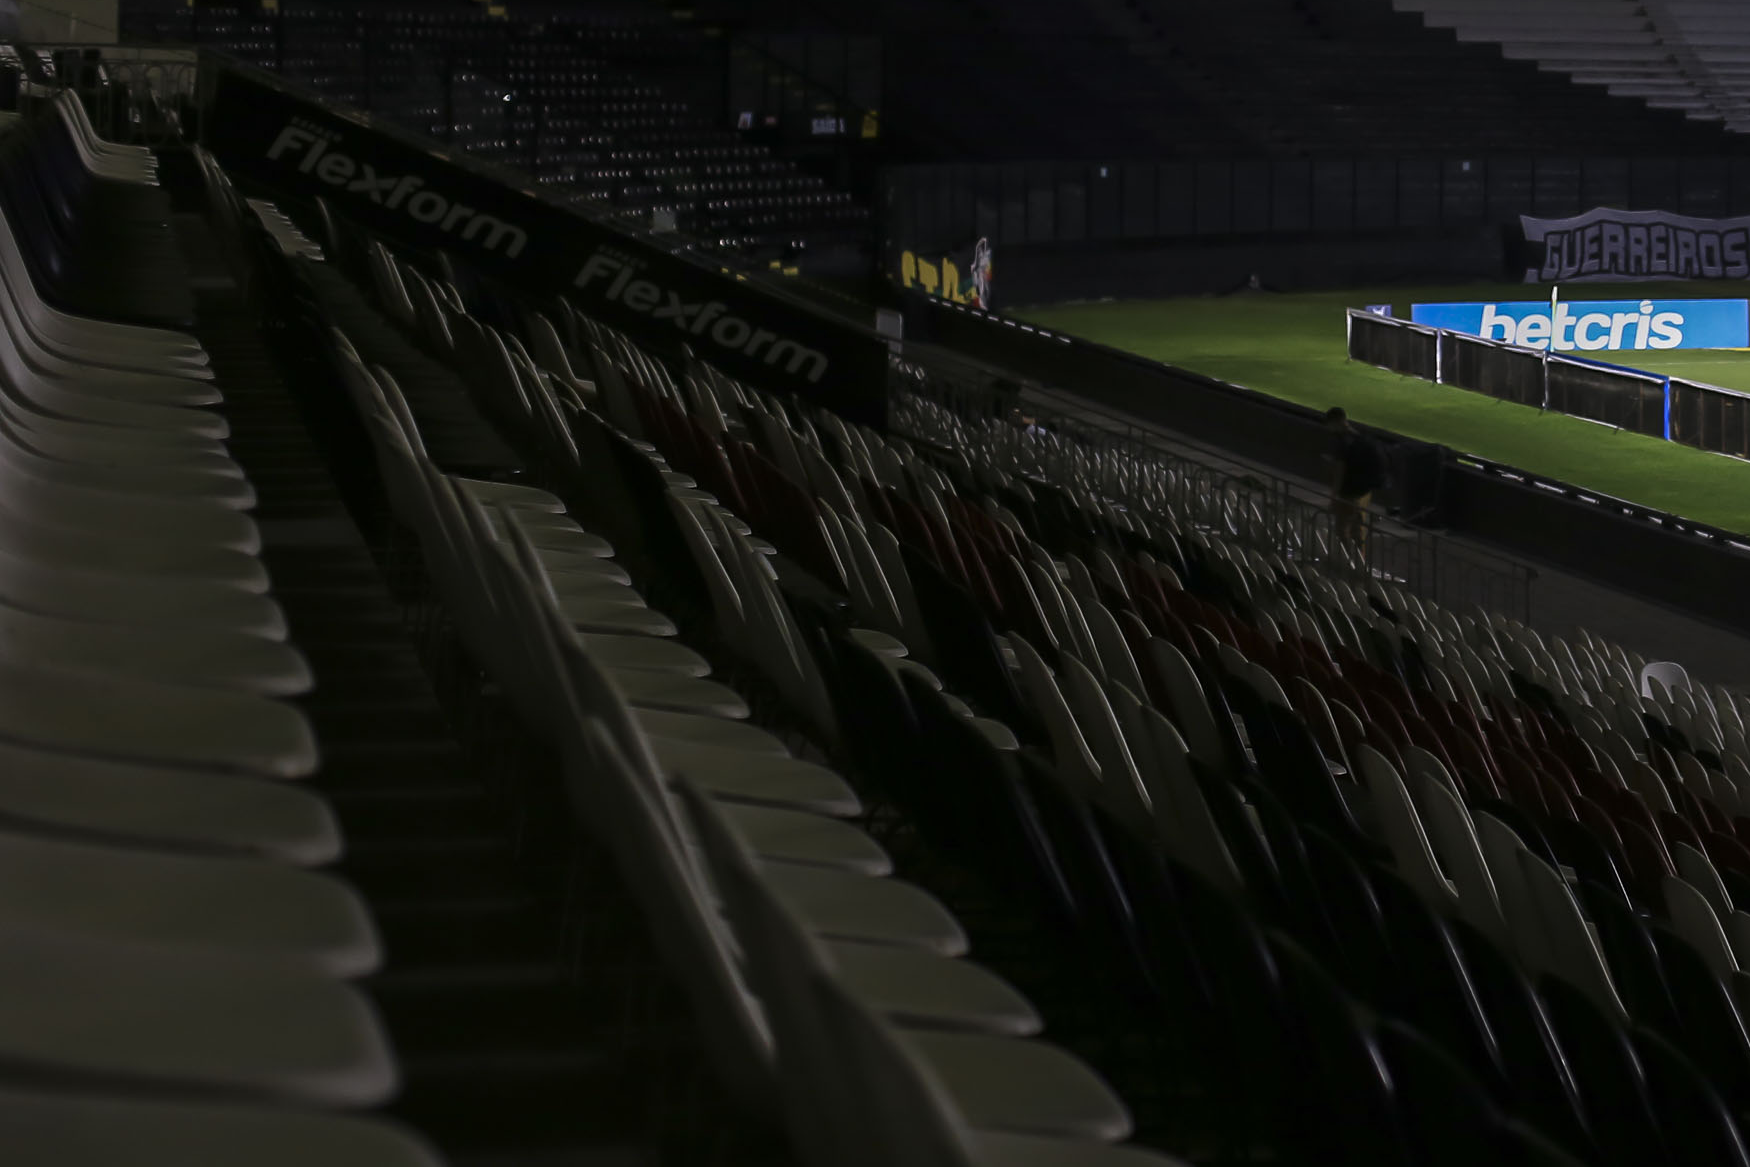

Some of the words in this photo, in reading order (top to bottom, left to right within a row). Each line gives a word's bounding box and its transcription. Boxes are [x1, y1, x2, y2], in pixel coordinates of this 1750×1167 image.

[264, 125, 528, 260] Flexform
[1539, 220, 1750, 282] GUERREIROS
[573, 254, 829, 384] Flexform
[1480, 300, 1684, 351] betcris
